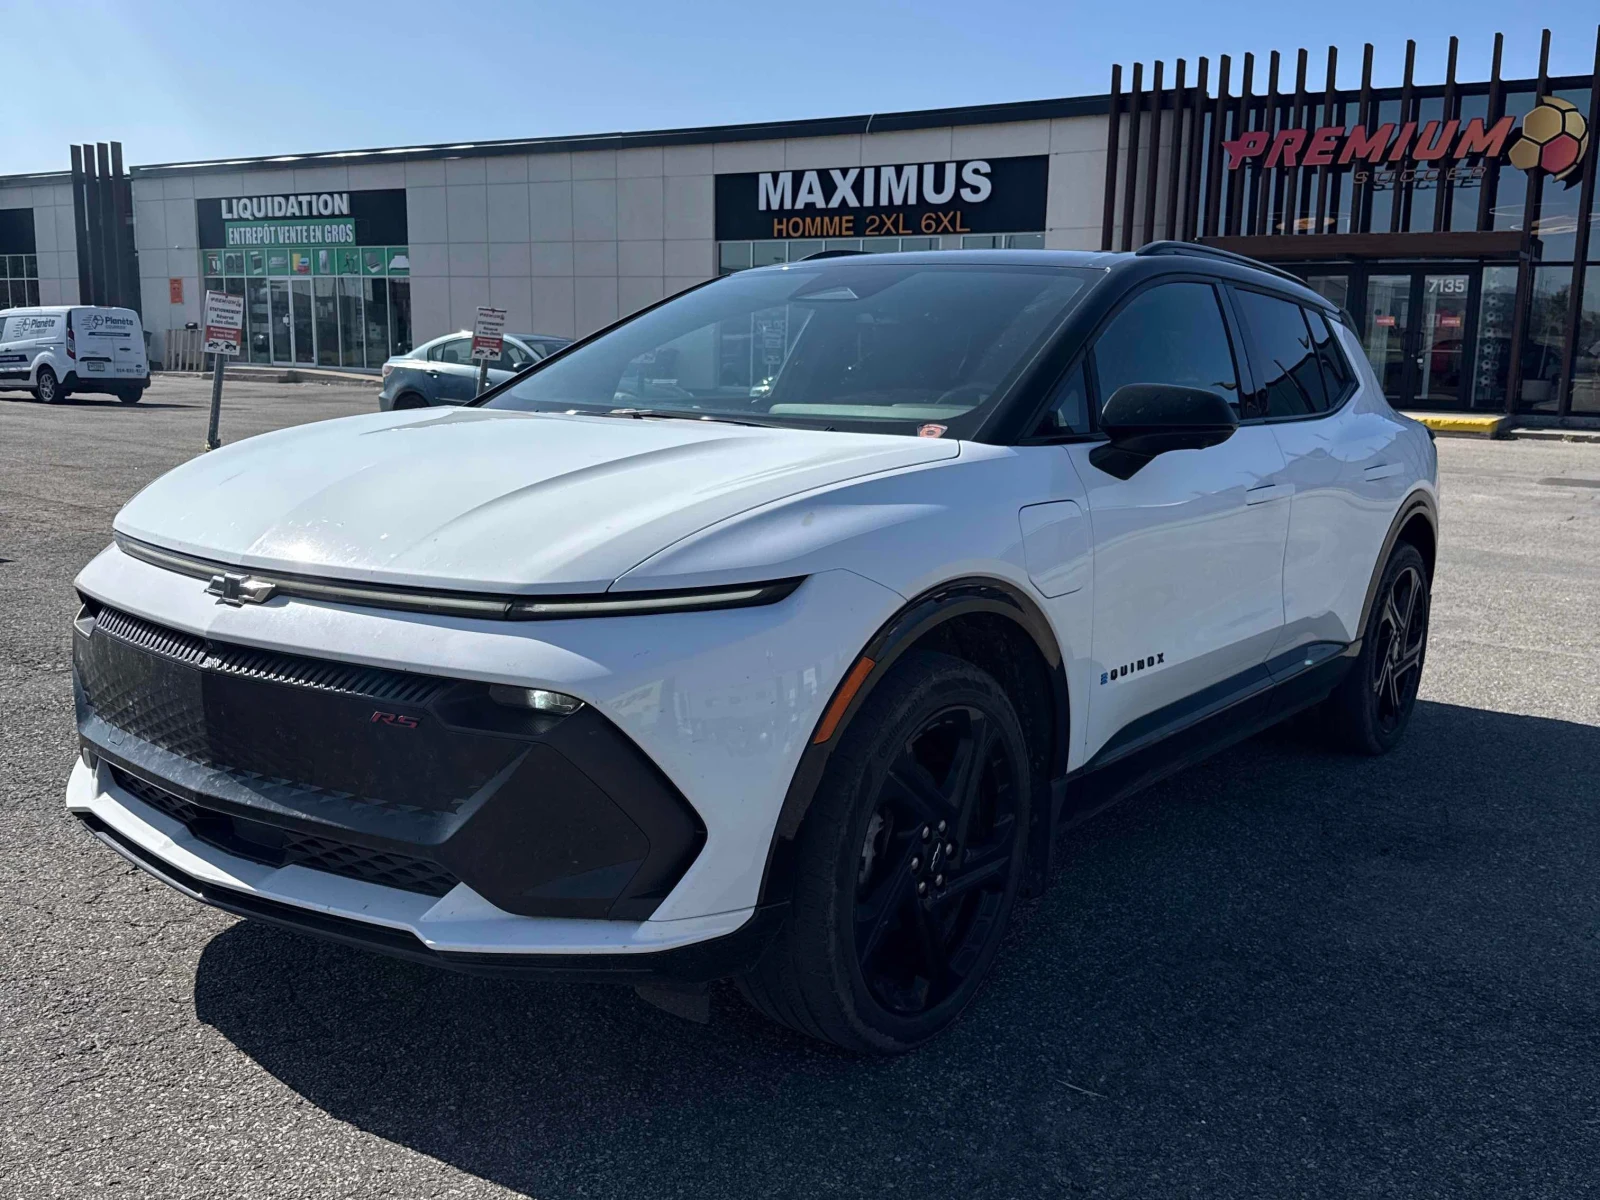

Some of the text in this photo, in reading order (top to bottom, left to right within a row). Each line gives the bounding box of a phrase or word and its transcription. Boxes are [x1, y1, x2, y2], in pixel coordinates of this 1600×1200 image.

[1221, 116, 1516, 170] PREMIUM
[758, 160, 992, 211] MAXIMUS
[221, 193, 350, 220] LIQUIDATION
[228, 223, 353, 245] ENTREPÔT VENTE EN GROS
[773, 211, 971, 237] HOMME 2XL 6XL
[1428, 279, 1465, 293] 7135
[1100, 652, 1164, 685] EQUINOX
[370, 711, 420, 729] RS
